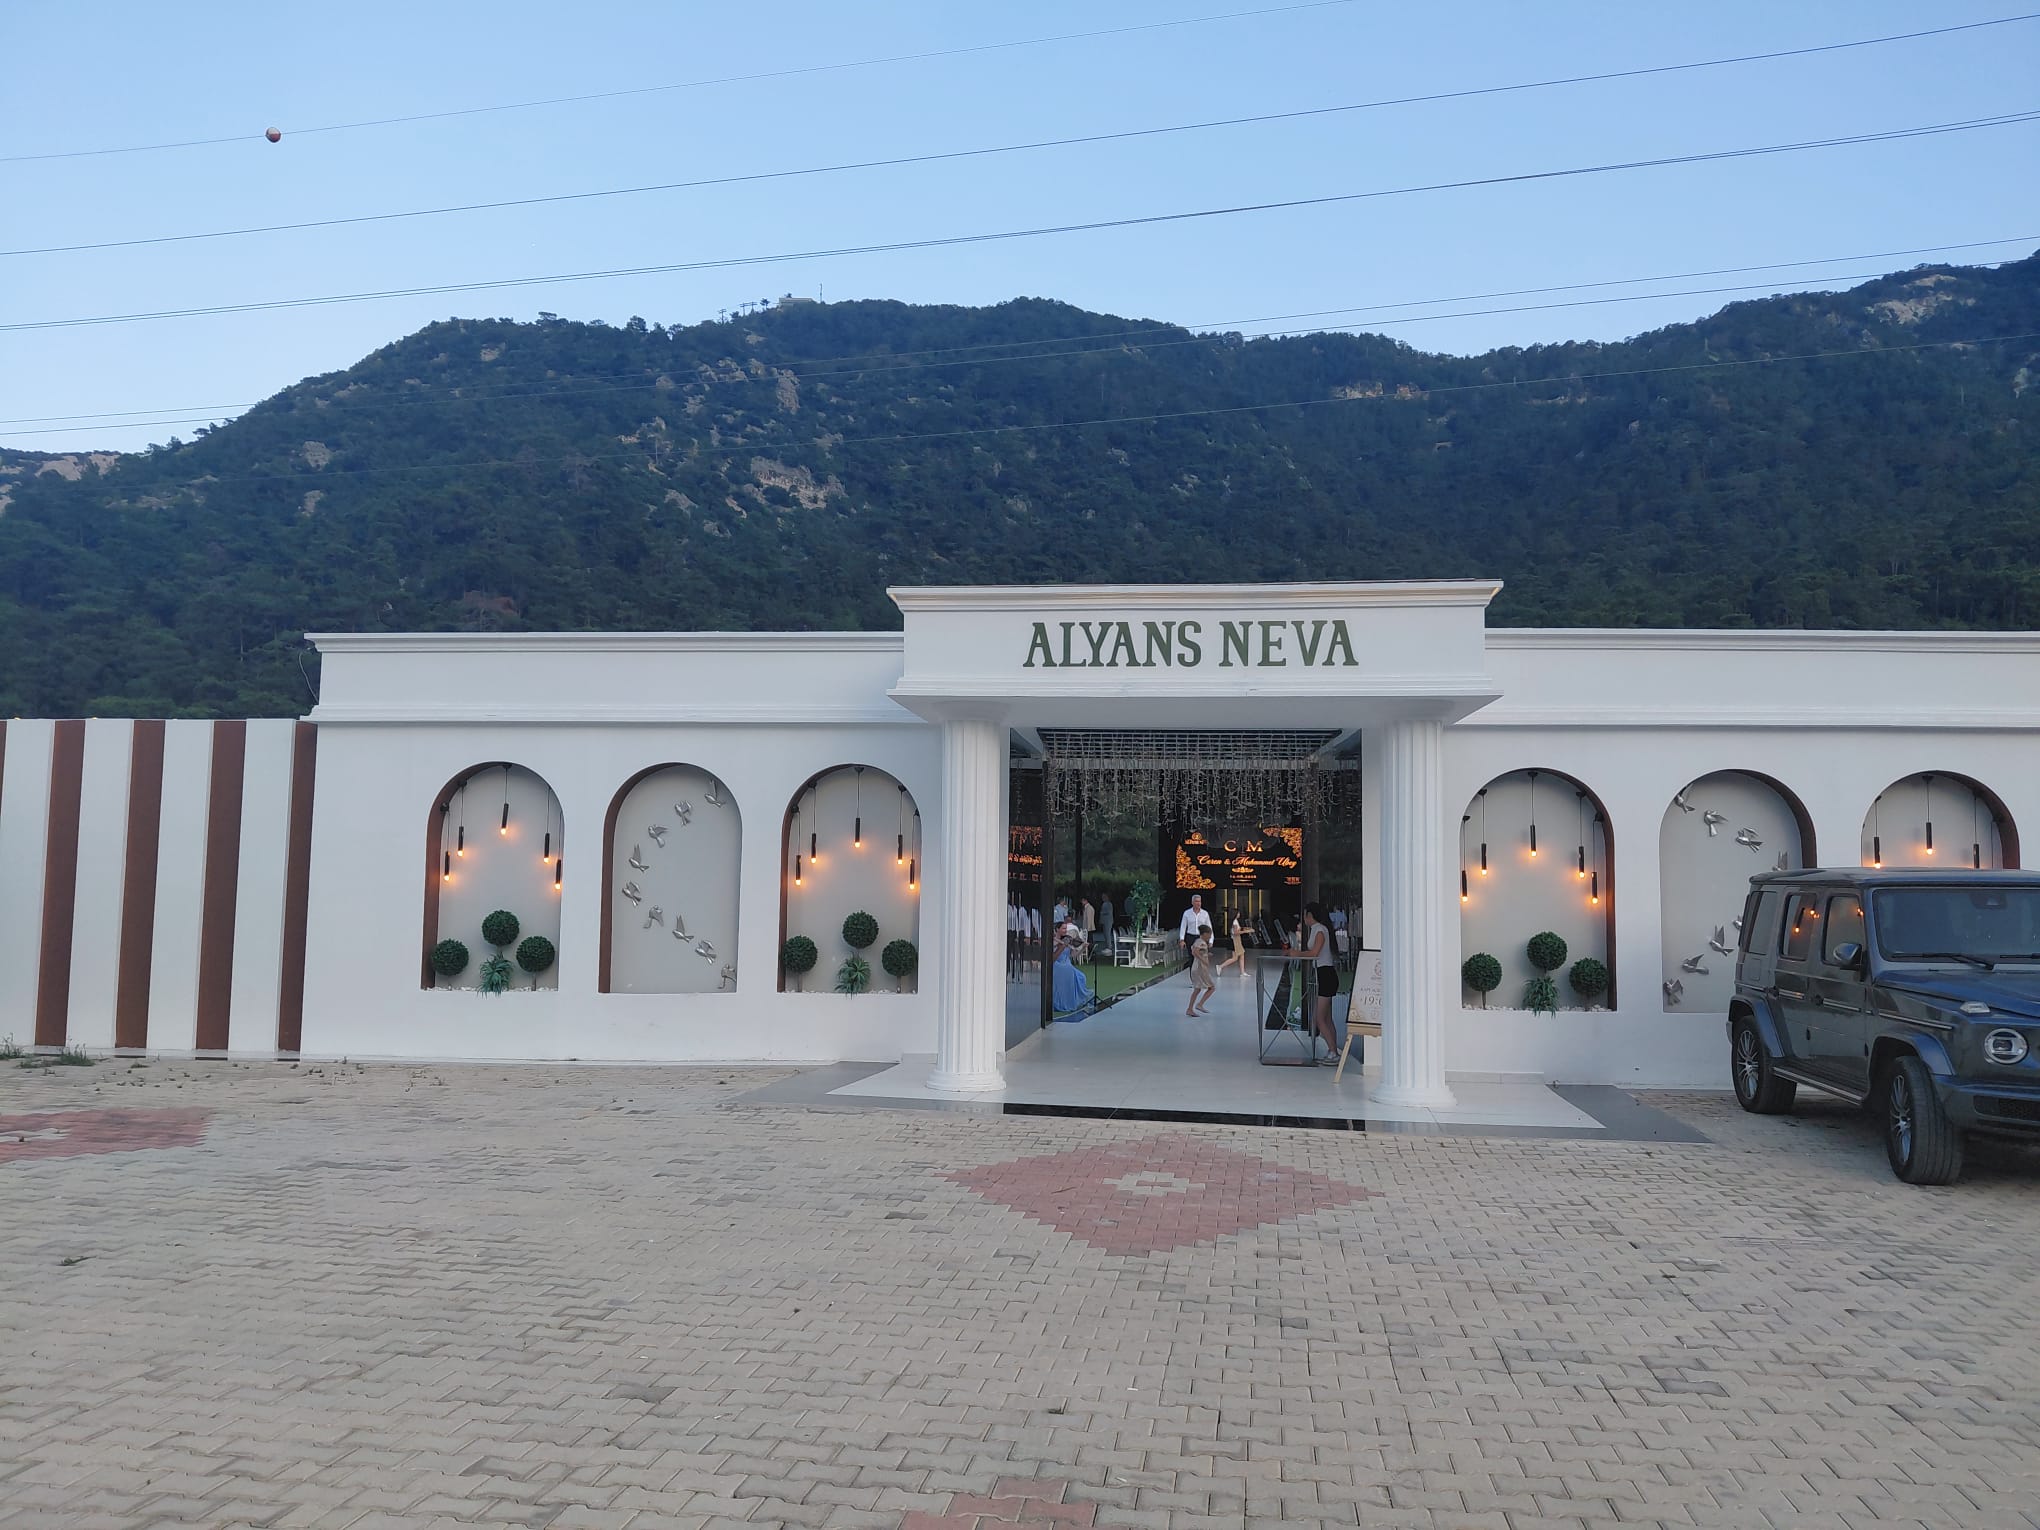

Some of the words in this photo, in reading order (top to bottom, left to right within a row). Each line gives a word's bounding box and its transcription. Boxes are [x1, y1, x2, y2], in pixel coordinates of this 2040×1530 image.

[1023, 620, 1202, 668] ALYANS
[1218, 619, 1360, 667] NEVA
[1224, 840, 1236, 852] C
[1246, 840, 1263, 852] M
